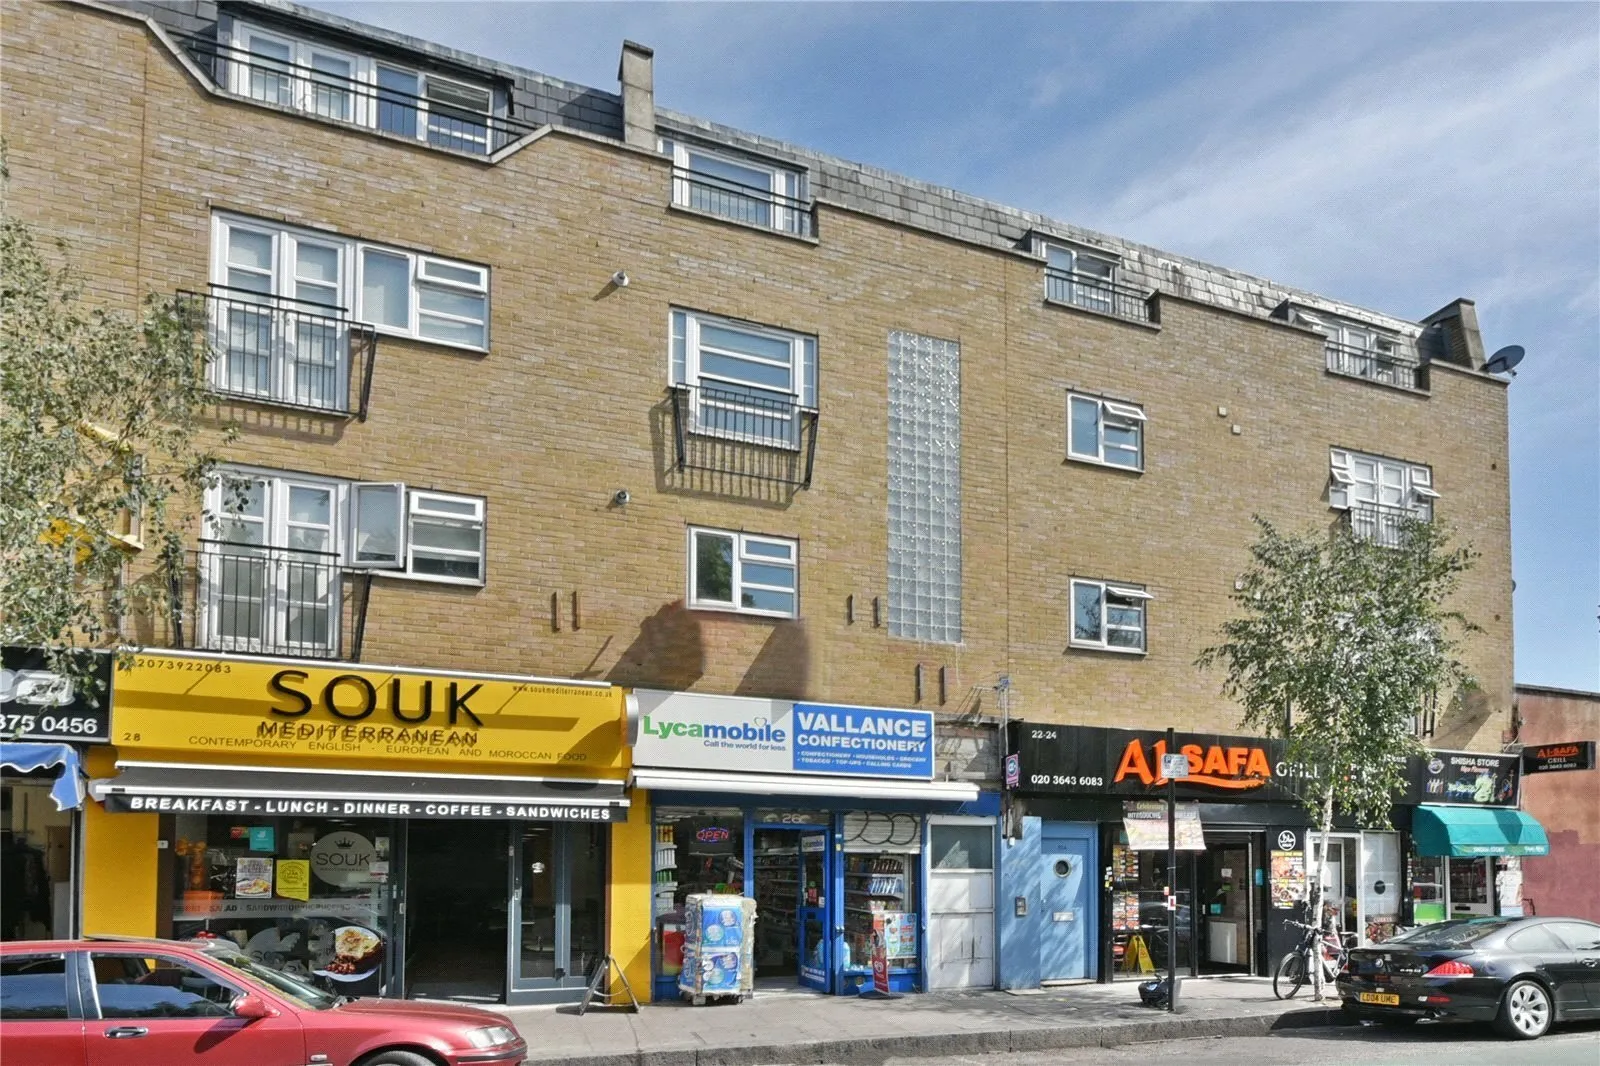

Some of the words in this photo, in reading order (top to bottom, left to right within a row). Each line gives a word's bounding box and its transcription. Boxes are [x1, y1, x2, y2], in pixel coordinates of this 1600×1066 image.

[270, 669, 485, 728] SOUK
[41, 716, 98, 734] 0456
[258, 721, 479, 745] MEDITERRANEAN
[642, 715, 786, 743] Lycamobile
[797, 711, 927, 738] VALLANCE
[123, 732, 141, 742] 28
[797, 733, 927, 753] CONFECTIONERY
[1031, 730, 1057, 740] 22-24
[188, 735, 297, 750] CONTEMPORARY
[308, 741, 361, 752] ENGLISH
[386, 744, 450, 756] EUROPEAN
[459, 749, 482, 758] AND
[488, 750, 552, 761] MOROCCAN
[557, 752, 588, 762] FOOD
[703, 739, 720, 748] Call
[720, 741, 735, 749] the
[735, 742, 758, 751] world
[1180, 744, 1272, 778] SAFA
[1476, 758, 1500, 768] STORE
[1030, 774, 1050, 785] 020
[1053, 775, 1077, 785] 3643
[1079, 776, 1103, 787] 6083
[130, 796, 249, 812] BREAKFAST
[265, 800, 328, 813] LUNCH
[343, 802, 410, 815] DINNER
[425, 803, 492, 817] COFFEE
[506, 805, 611, 820] SANDWICHES
[696, 830, 729, 840] OPEN
[315, 852, 371, 867] SOUK
